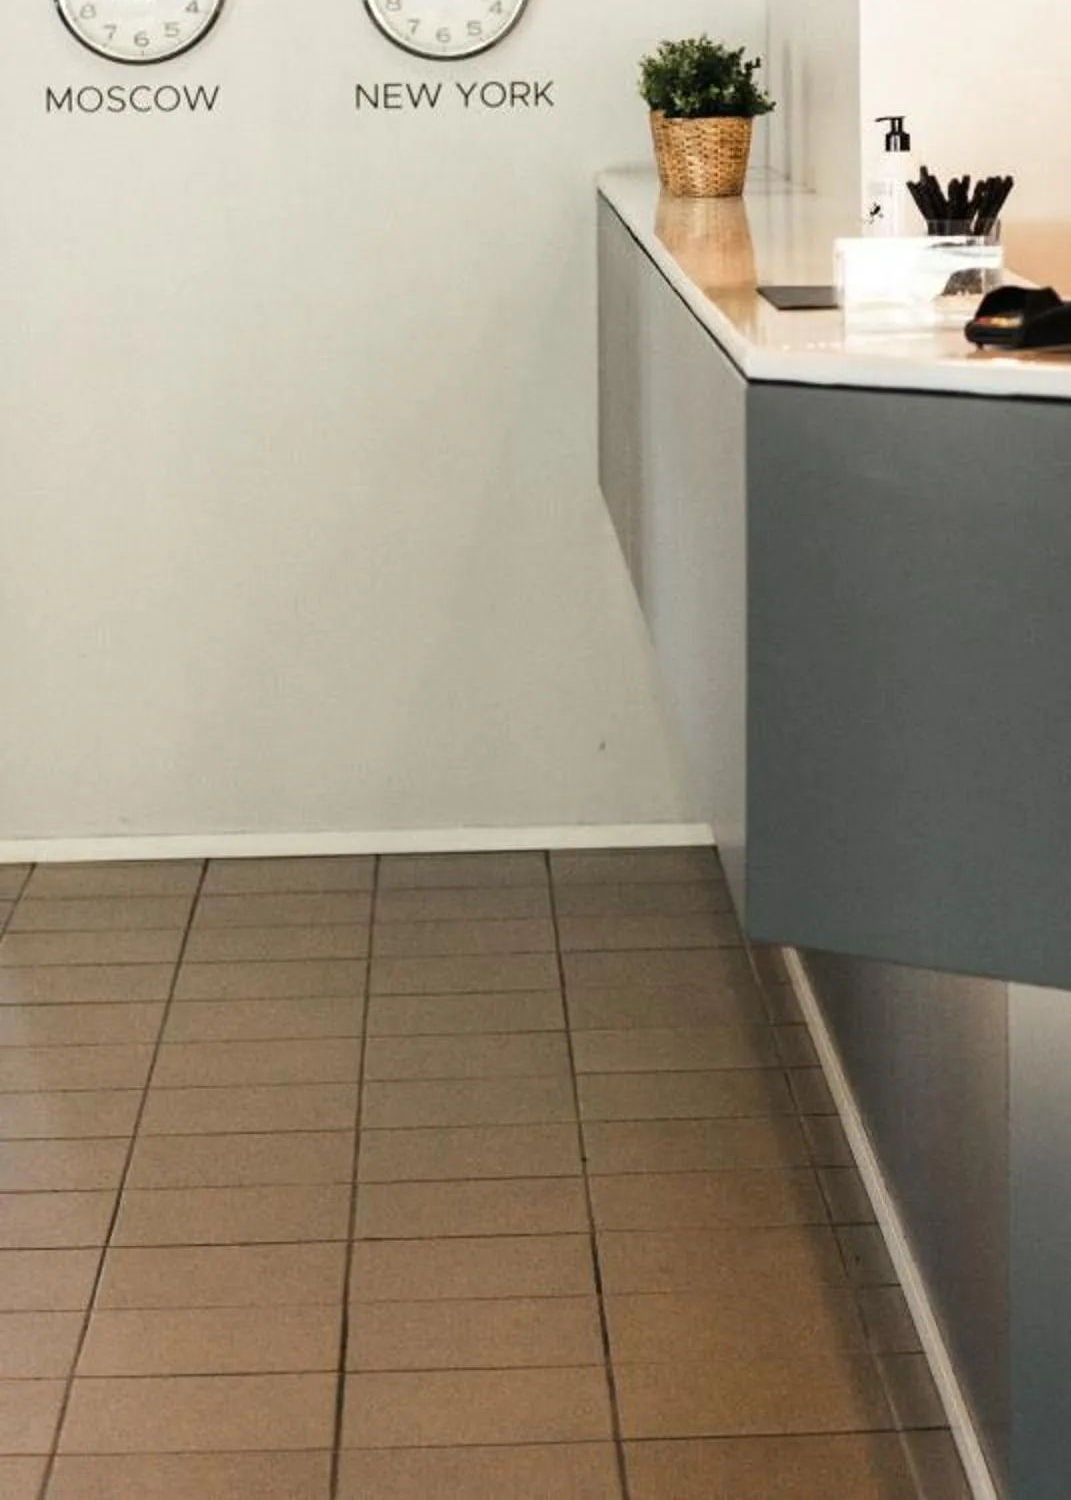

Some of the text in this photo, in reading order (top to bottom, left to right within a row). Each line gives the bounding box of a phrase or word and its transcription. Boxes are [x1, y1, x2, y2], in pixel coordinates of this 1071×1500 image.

[185, 0, 199, 13] 4
[104, 25, 117, 39] 7
[165, 22, 179, 37] 5
[408, 19, 420, 33] 7
[134, 31, 149, 47] 6
[436, 28, 450, 42] 6
[45, 85, 220, 112] MOSCOW
[355, 81, 554, 109] NEW YORK
